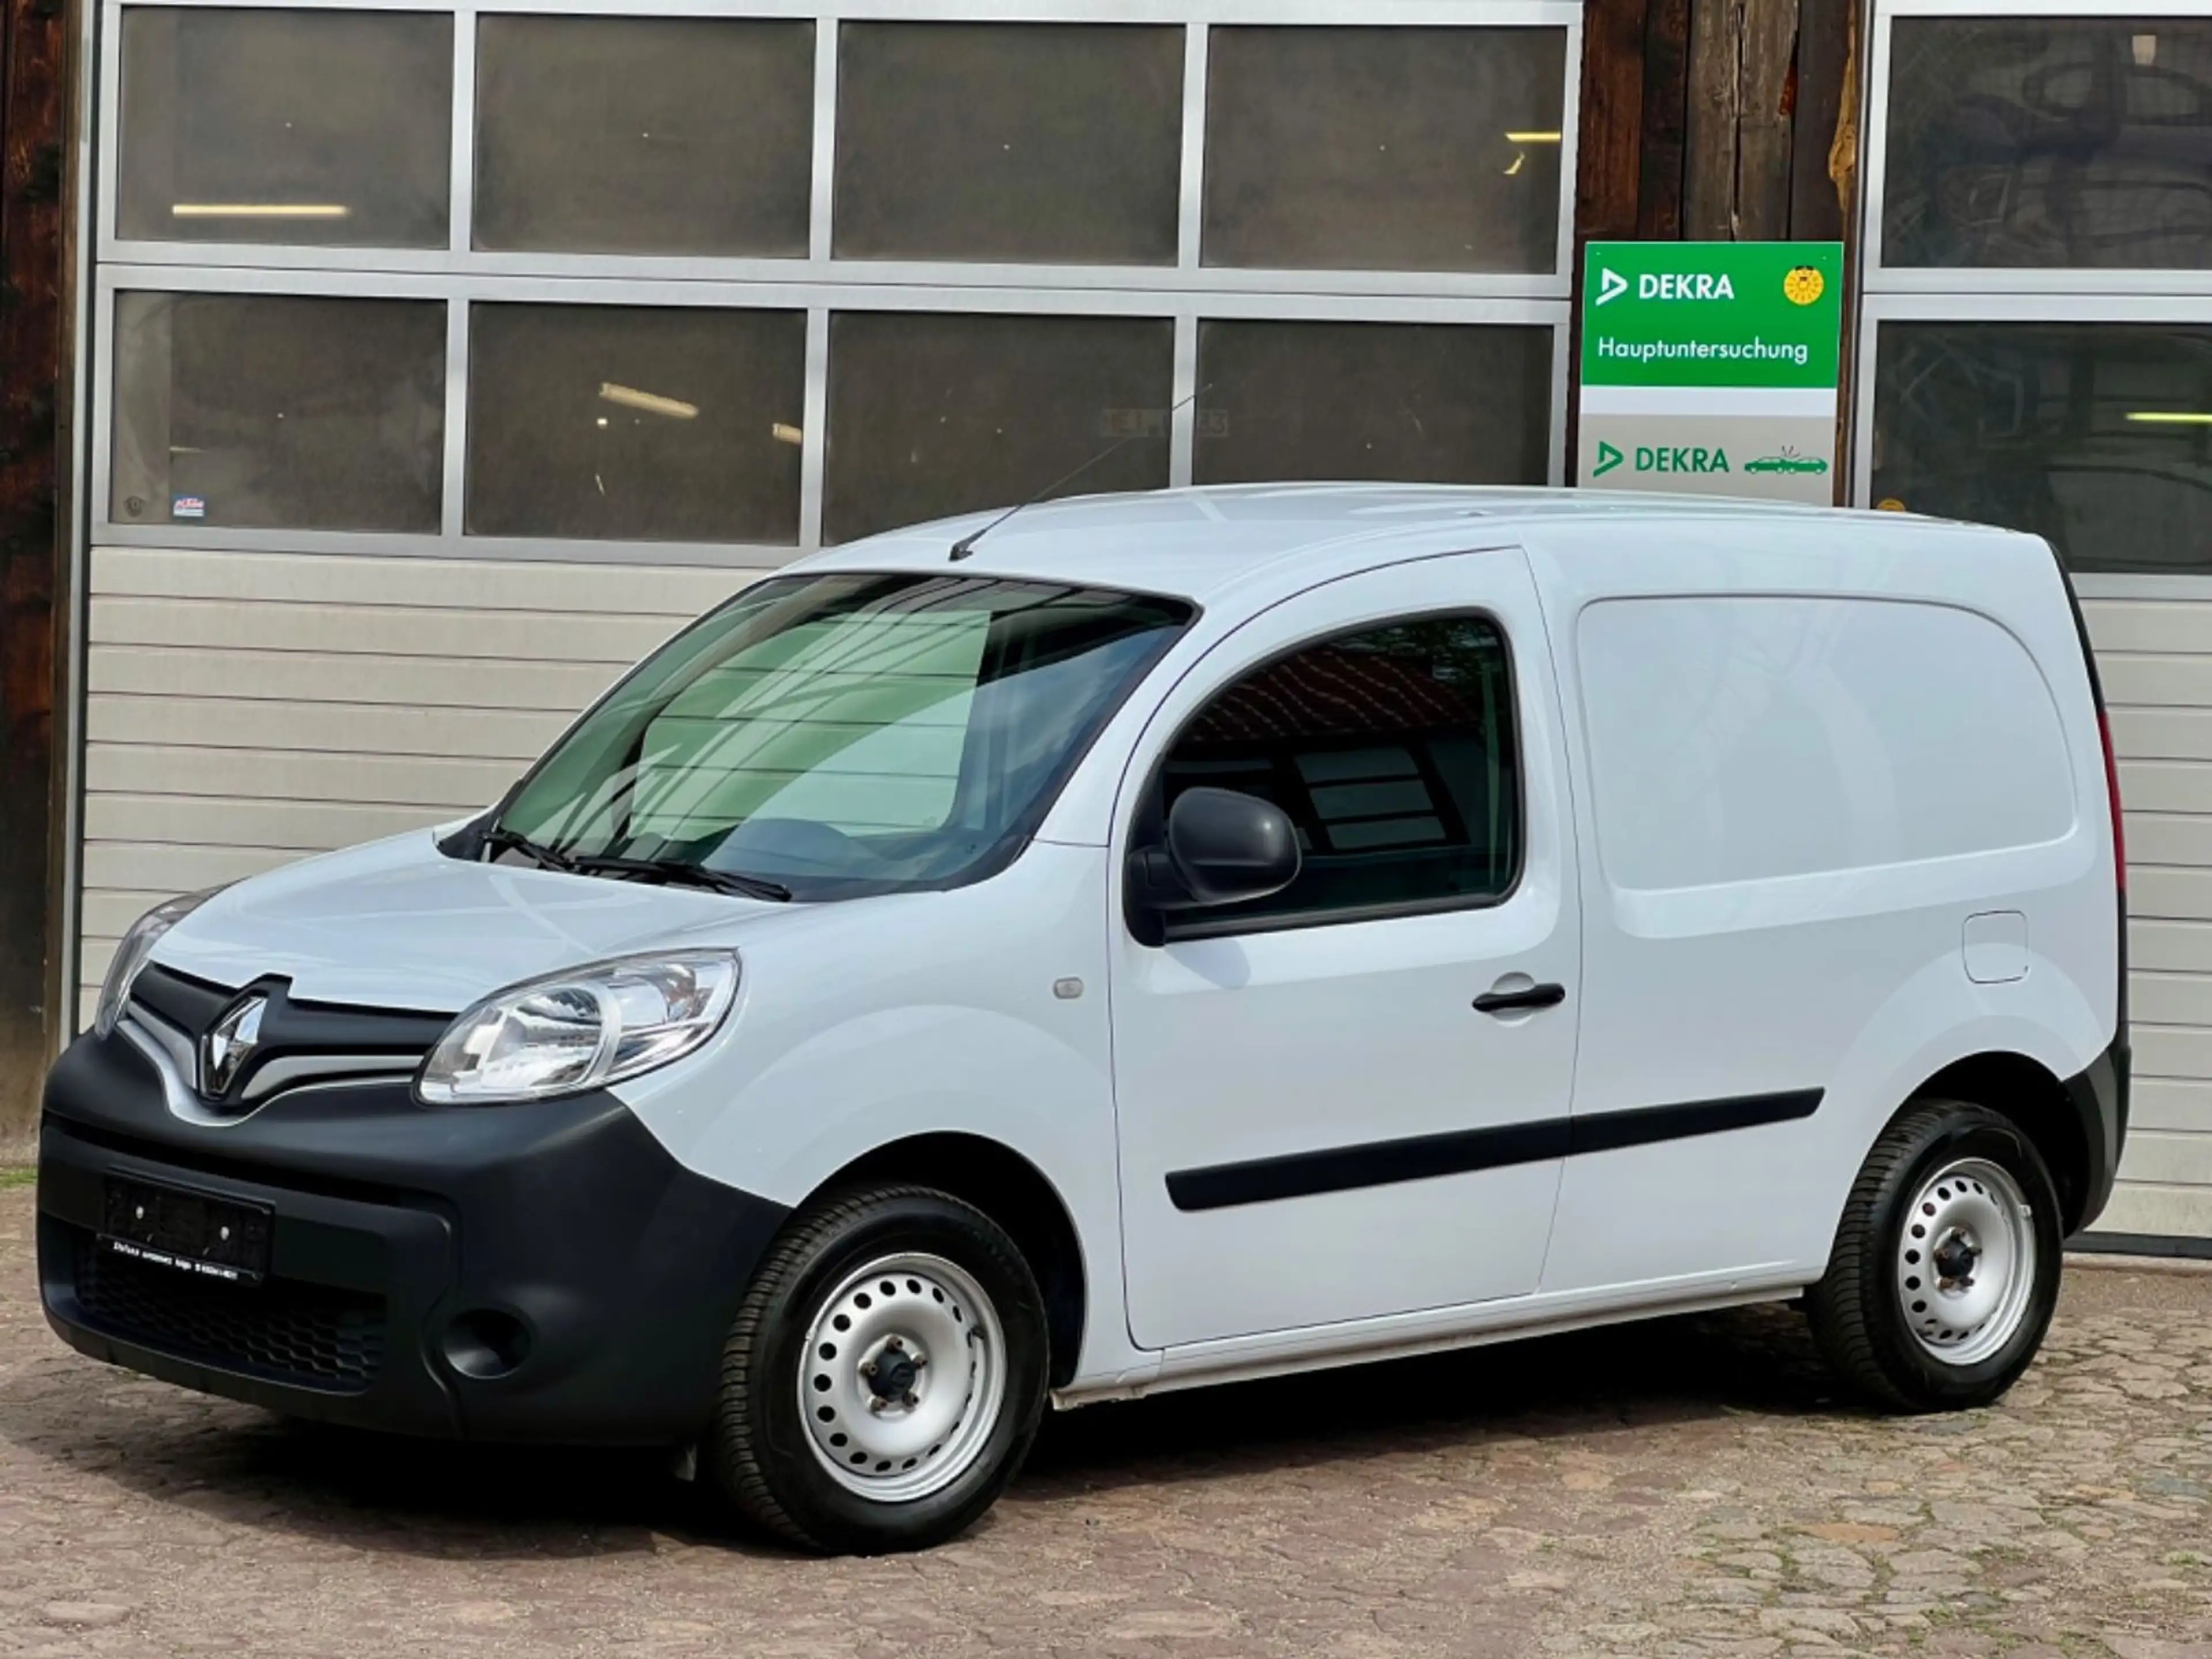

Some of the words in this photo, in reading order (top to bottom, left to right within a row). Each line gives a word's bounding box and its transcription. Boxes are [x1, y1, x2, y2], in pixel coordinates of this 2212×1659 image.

[1639, 274, 1735, 300] DEKRA
[1598, 336, 1808, 365] Hauptuntersuchung
[1635, 447, 1730, 473] DEKRA
